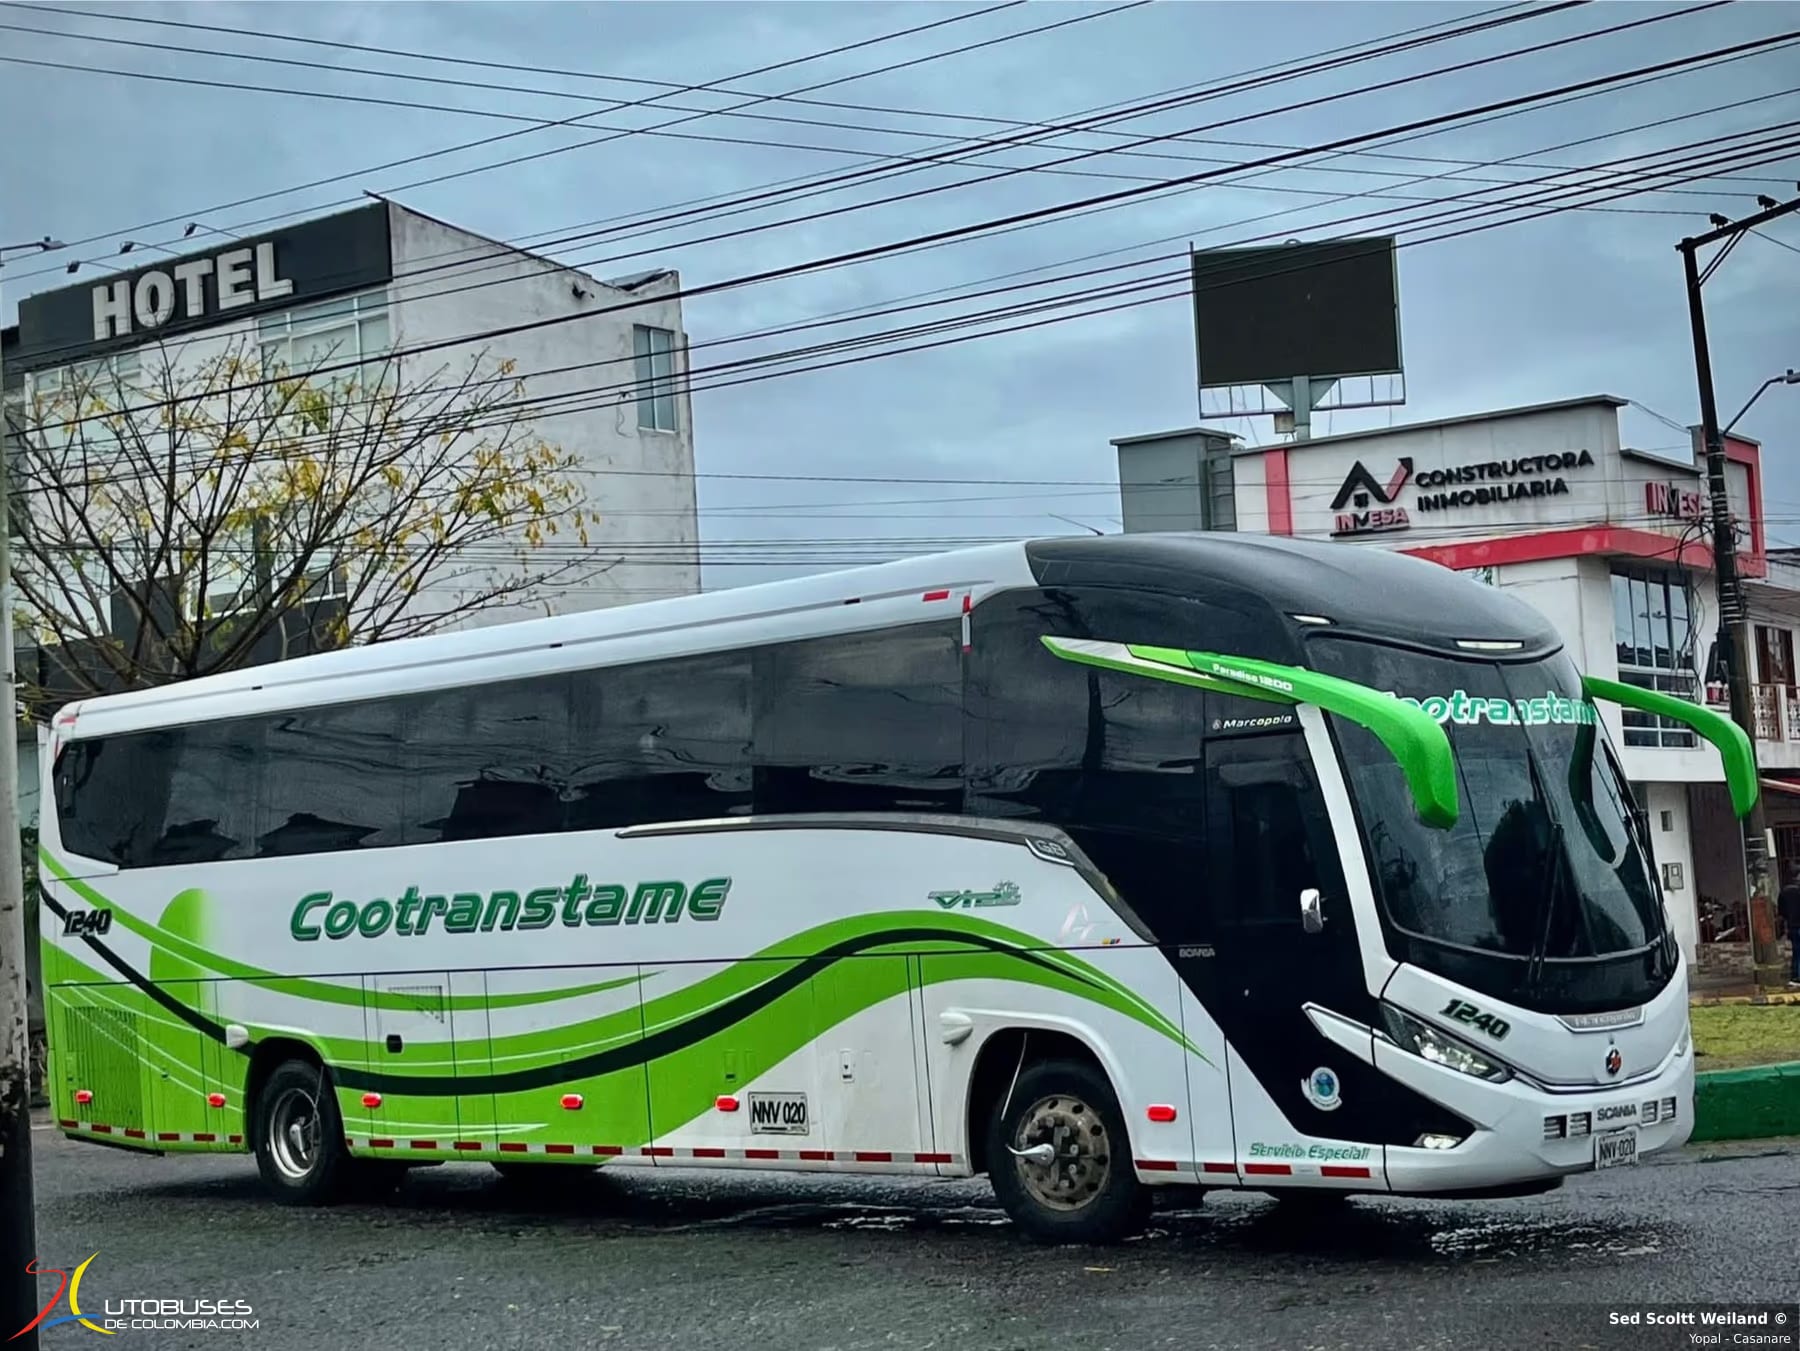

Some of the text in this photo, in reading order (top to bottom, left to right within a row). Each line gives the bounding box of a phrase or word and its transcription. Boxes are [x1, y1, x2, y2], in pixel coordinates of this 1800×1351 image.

[92, 241, 294, 341] HOTEL
[1414, 449, 1595, 488] CONSTRUCTORA
[1417, 477, 1569, 512] INMOBILIARIA
[1645, 480, 1704, 519] INVES
[1334, 507, 1411, 532] INVESA
[1259, 675, 1293, 692] 1200
[1222, 714, 1293, 729] Marcopolo
[1381, 689, 1597, 725] otranstam
[62, 908, 112, 937] 1240
[289, 872, 732, 941] Cootranstame
[1438, 998, 1511, 1042] 1240
[752, 1100, 806, 1124] NNV 020
[1597, 1103, 1638, 1121] SCANIA
